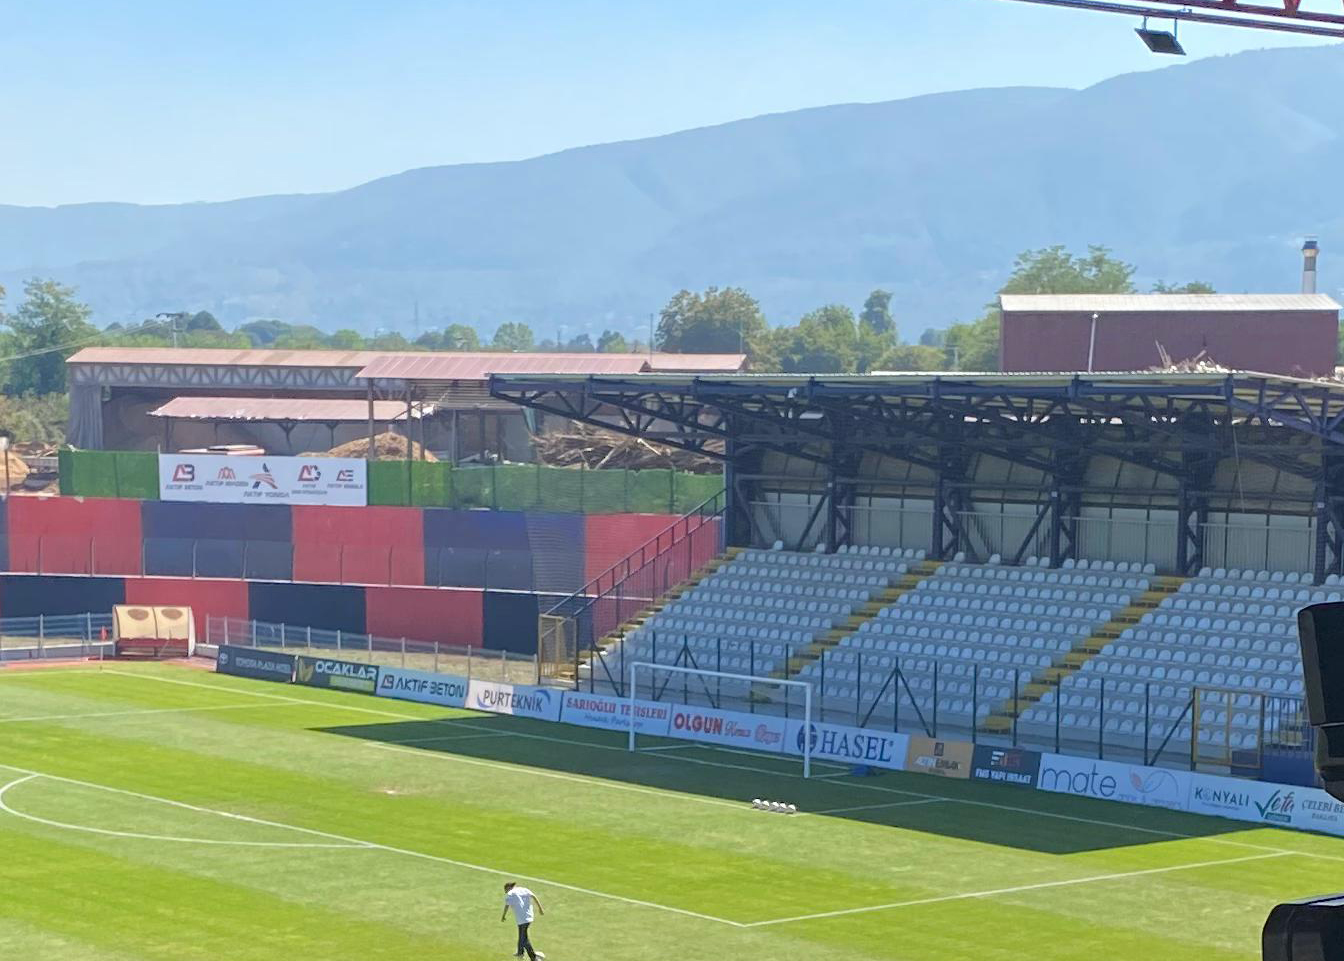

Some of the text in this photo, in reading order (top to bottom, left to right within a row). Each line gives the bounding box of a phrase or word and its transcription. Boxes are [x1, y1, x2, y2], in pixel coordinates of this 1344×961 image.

[315, 660, 377, 681] OCAKLAR
[674, 713, 724, 734] OLGUN
[1039, 763, 1117, 797] mate
